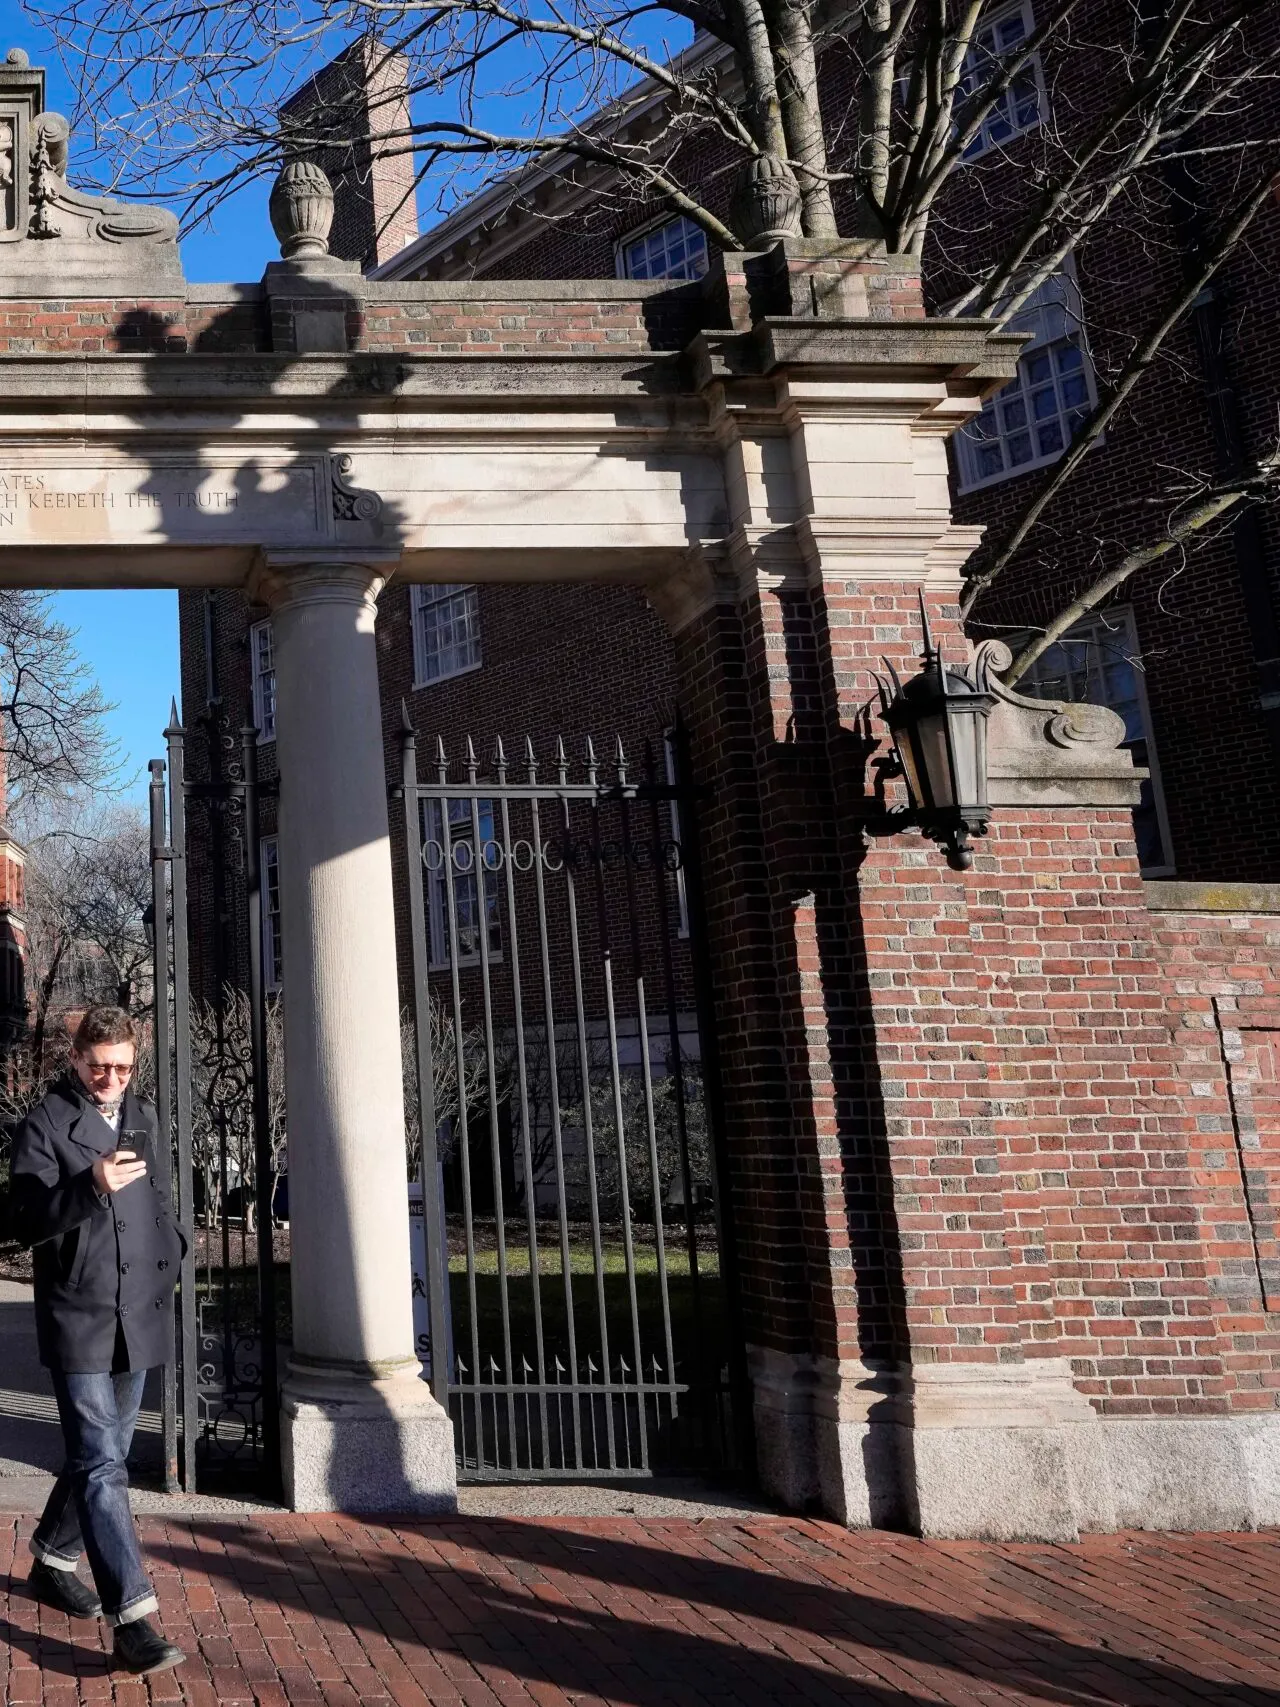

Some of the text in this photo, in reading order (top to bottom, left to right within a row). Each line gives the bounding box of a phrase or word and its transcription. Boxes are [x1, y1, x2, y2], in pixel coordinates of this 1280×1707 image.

[28, 492, 114, 509] KEEPETH
[125, 492, 163, 508] THE
[175, 491, 239, 508] TRUTH
